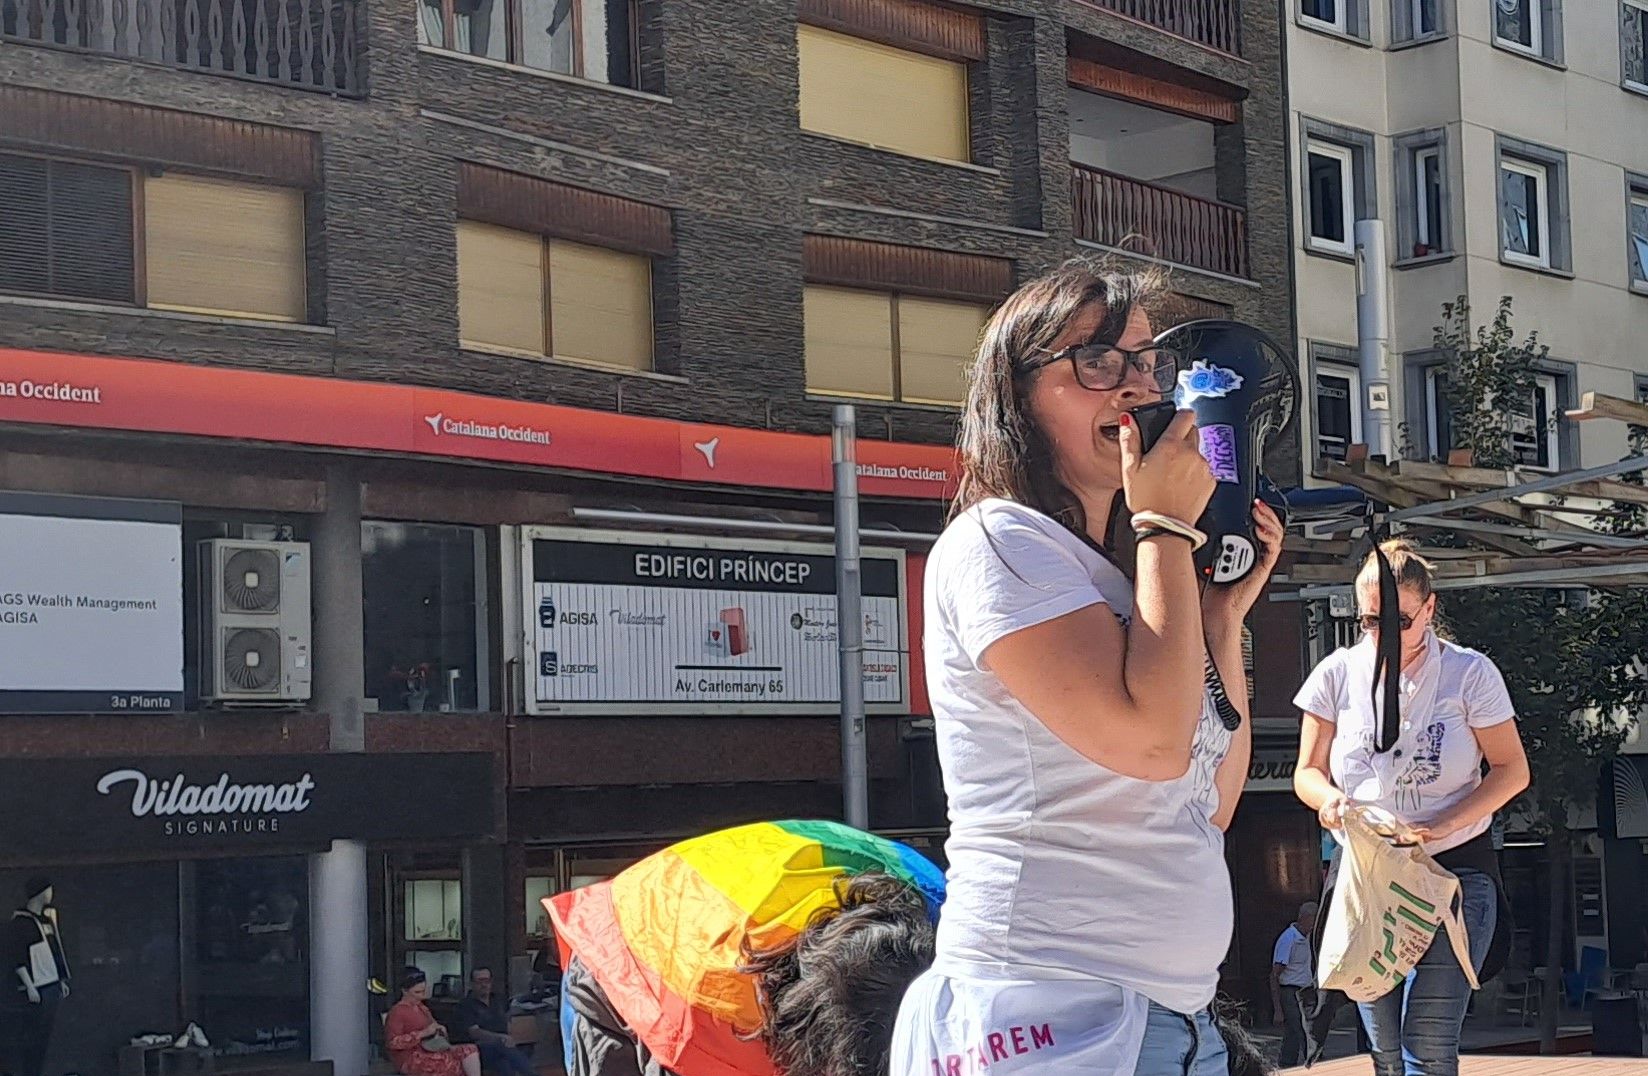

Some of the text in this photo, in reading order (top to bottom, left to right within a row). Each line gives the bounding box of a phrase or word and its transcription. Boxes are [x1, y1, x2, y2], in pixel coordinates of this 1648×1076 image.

[20, 380, 101, 403] Occident
[443, 418, 550, 444] Catalana Occident
[856, 464, 947, 481] atalana Occident
[635, 553, 811, 585] EDIFICI PRÍNCEP
[27, 594, 73, 607] Wealth
[76, 596, 157, 612] Management
[559, 612, 599, 626] AGISA
[675, 679, 783, 696] Av. Carlemany 65
[111, 695, 171, 708] 3a Planta
[97, 769, 315, 816] Viladomat
[165, 818, 279, 835] SIGNATURE
